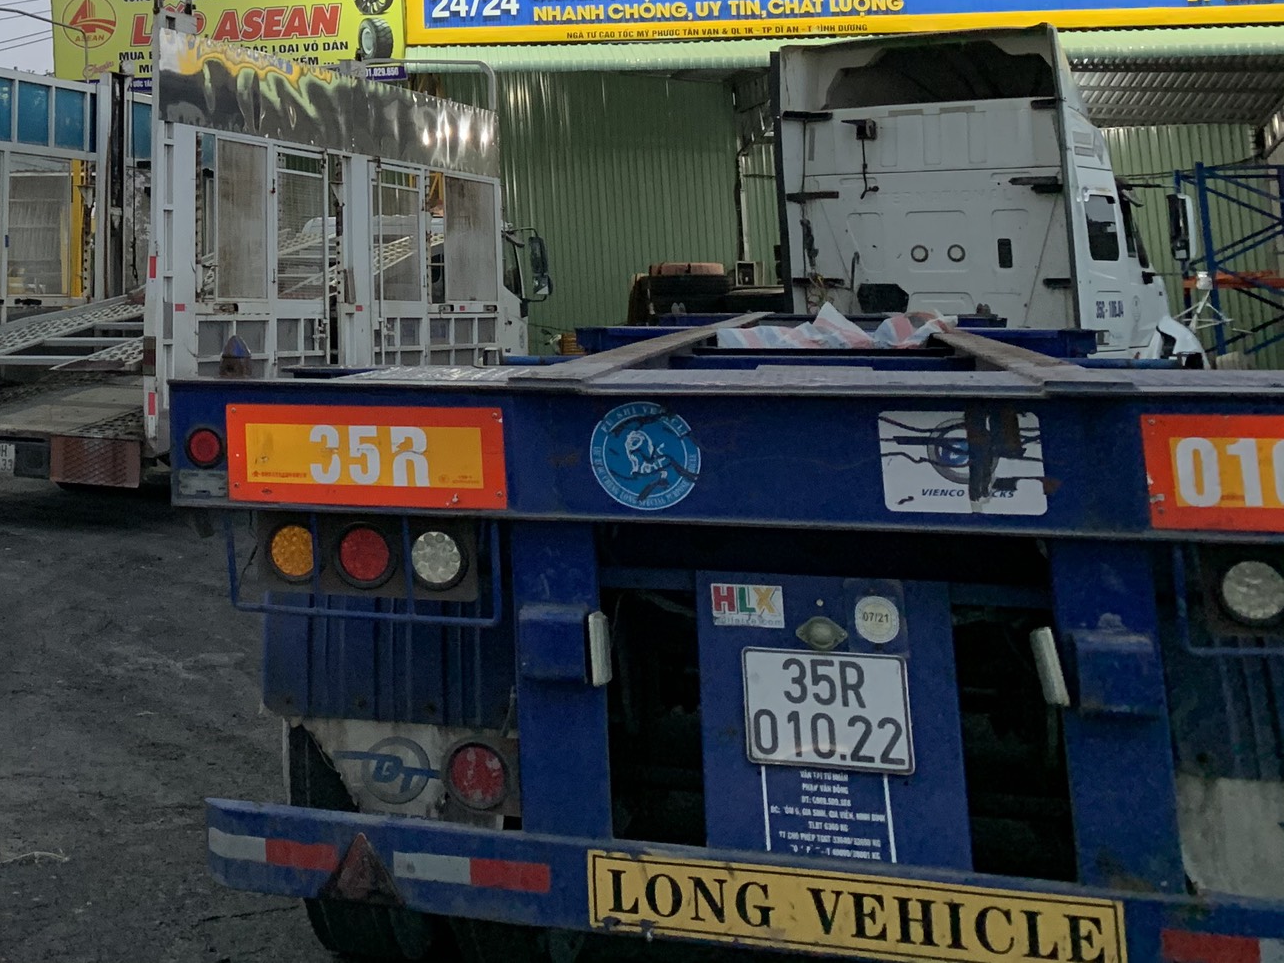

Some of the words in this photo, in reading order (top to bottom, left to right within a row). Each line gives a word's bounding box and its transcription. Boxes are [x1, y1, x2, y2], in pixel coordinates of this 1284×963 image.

[212, 3, 342, 42] ASEAN
[533, 3, 605, 21] NHANH
[696, 1, 722, 17] UY
[618, 29, 634, 38] TỐC
[762, 26, 772, 34] TP
[786, 26, 799, 34] AN
[119, 51, 145, 61] MUA
[323, 40, 348, 51] DÁN
[309, 424, 430, 487] 35R
[1176, 437, 1284, 507] 01
[921, 488, 965, 498] VIENCO
[712, 586, 778, 614] HLX
[863, 611, 890, 623] 07/21
[782, 657, 867, 709] 35R
[753, 708, 906, 766] 010.22
[607, 868, 776, 929] LONG
[805, 886, 1106, 963] VEHICLE
